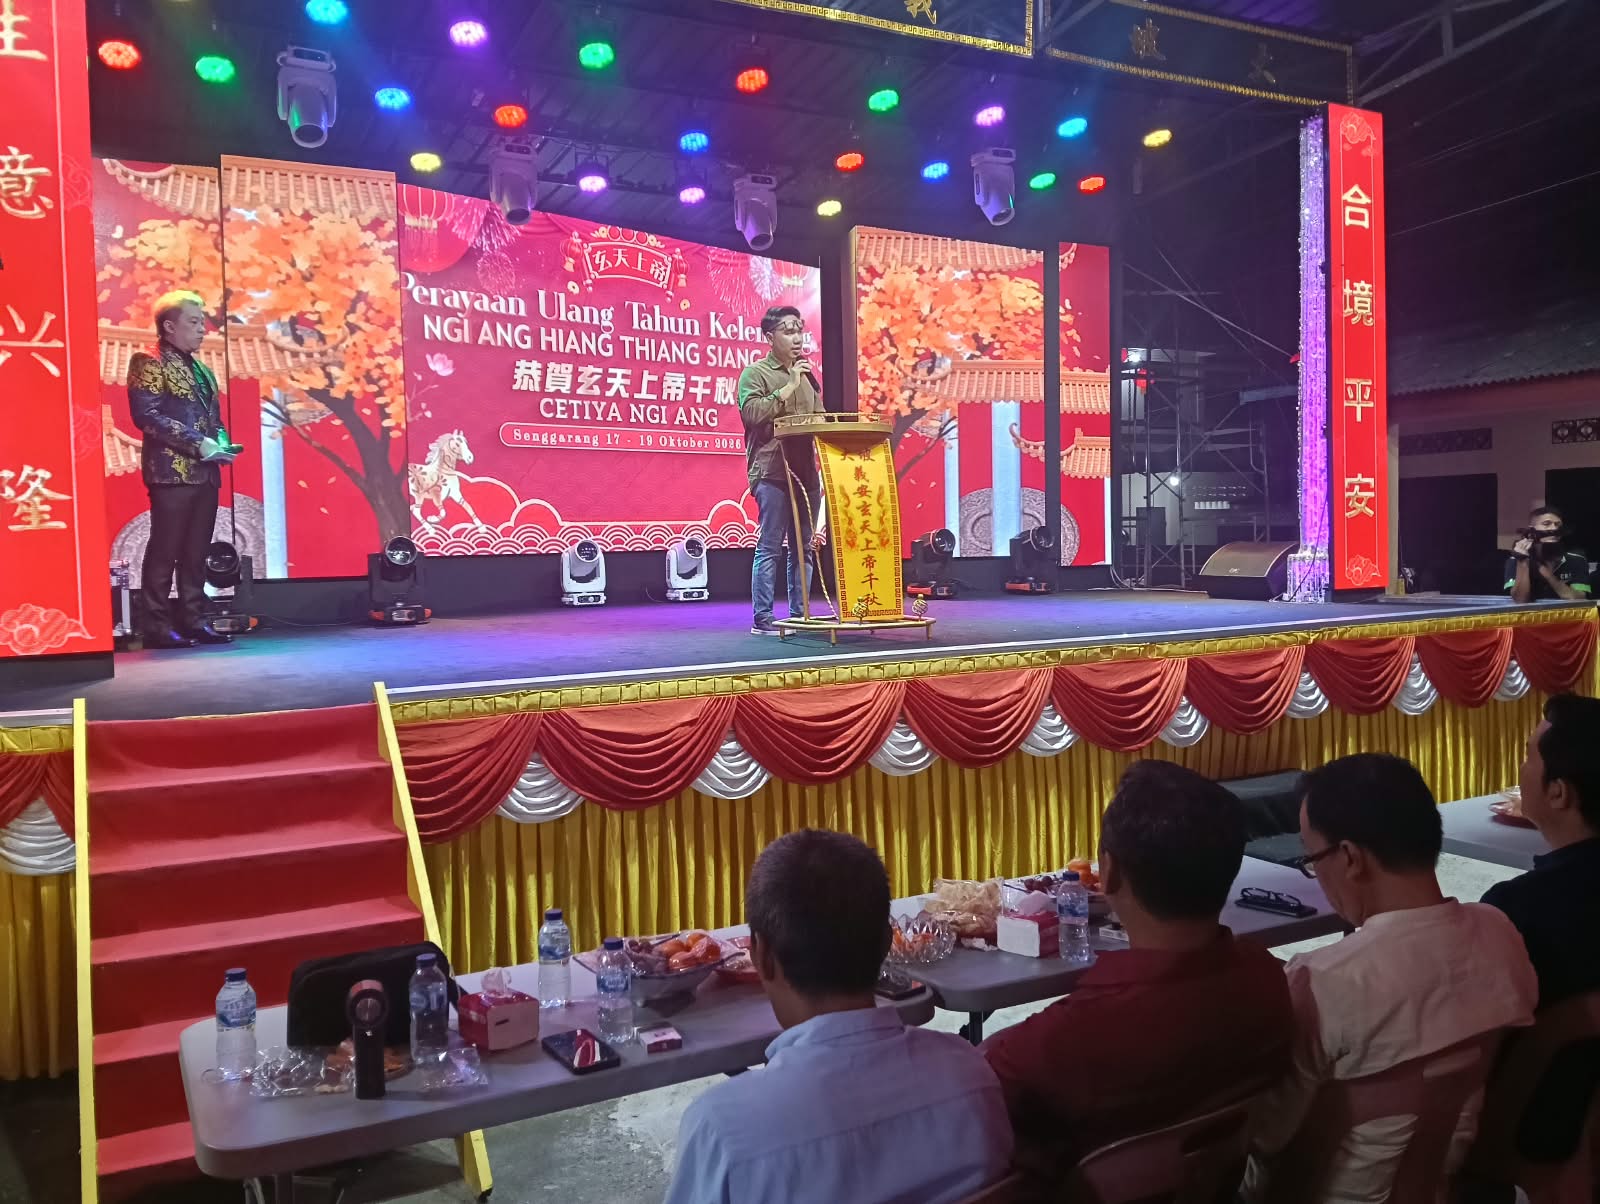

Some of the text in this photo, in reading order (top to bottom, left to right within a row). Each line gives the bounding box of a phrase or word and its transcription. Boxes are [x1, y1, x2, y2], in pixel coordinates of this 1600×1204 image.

[592, 248, 668, 282] 玄天上帝
[423, 314, 762, 369] NGI ANG HIANG THIANG SIANG
[537, 289, 615, 334] Ulang
[625, 300, 700, 336] Tahun
[709, 311, 814, 356] Keleng
[1341, 183, 1375, 519] 合境平安
[512, 359, 737, 405] 恭賀玄天上帝千秋
[539, 397, 719, 427] CETIYA NGI ANG
[513, 428, 600, 446] Senggarang
[606, 433, 621, 445] 17
[639, 434, 653, 446] 19
[659, 435, 710, 448] Oktober
